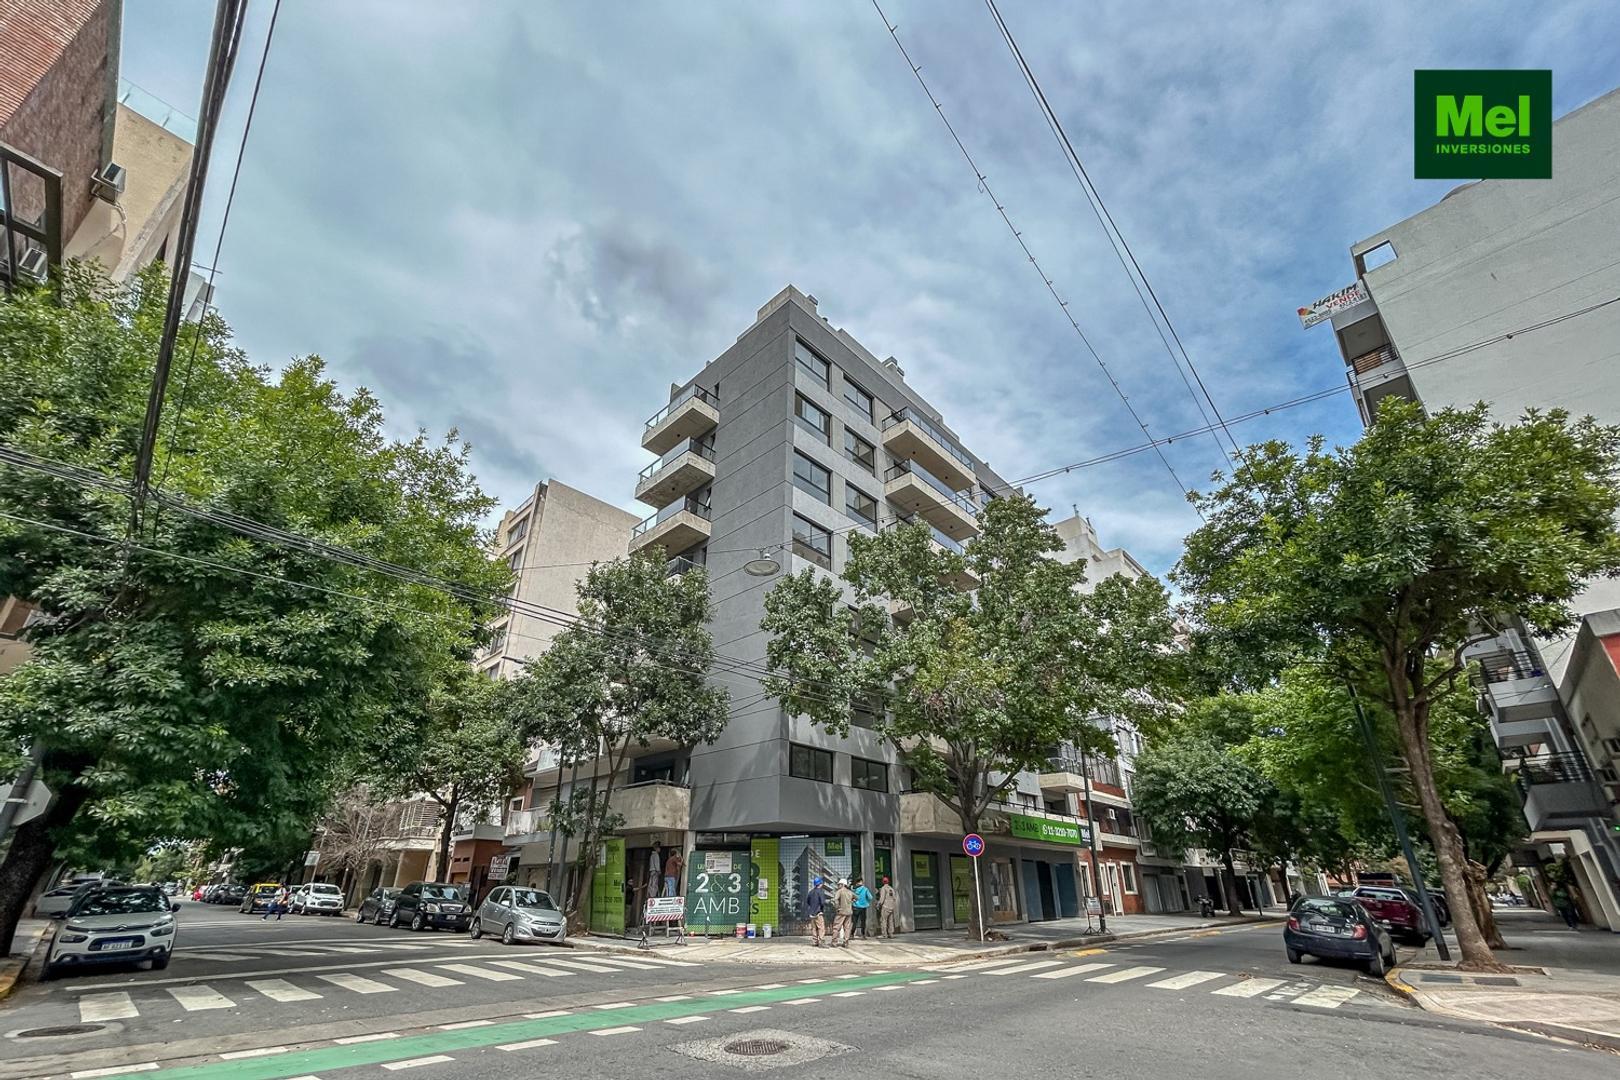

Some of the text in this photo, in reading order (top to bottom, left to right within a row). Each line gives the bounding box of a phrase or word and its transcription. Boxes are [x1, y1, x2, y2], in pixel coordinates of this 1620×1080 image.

[1313, 283, 1358, 309] HAKIM
[1326, 290, 1361, 309] VENDE
[828, 842, 843, 850] Mel
[693, 897, 740, 915] AMB
